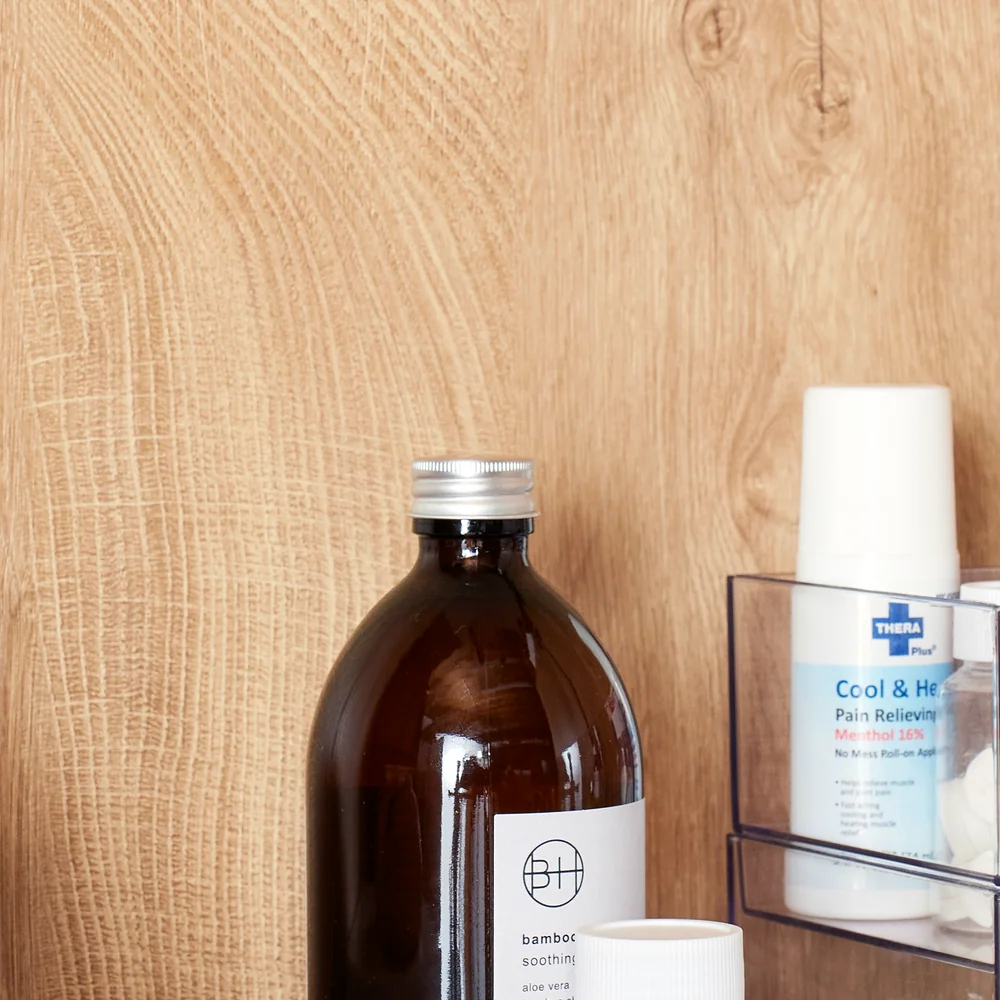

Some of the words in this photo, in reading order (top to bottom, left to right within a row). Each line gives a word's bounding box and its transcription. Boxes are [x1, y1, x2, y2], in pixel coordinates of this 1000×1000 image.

[875, 621, 921, 635] THERA
[836, 678, 884, 699] Cool
[892, 678, 909, 699] &
[916, 678, 938, 698] He
[835, 707, 869, 722] Pain
[834, 727, 895, 741] Menthol
[898, 727, 925, 741] 16%
[835, 748, 849, 758] No
[851, 748, 878, 759] Mess
[522, 982, 545, 993] aloe
[548, 982, 570, 991] vera
